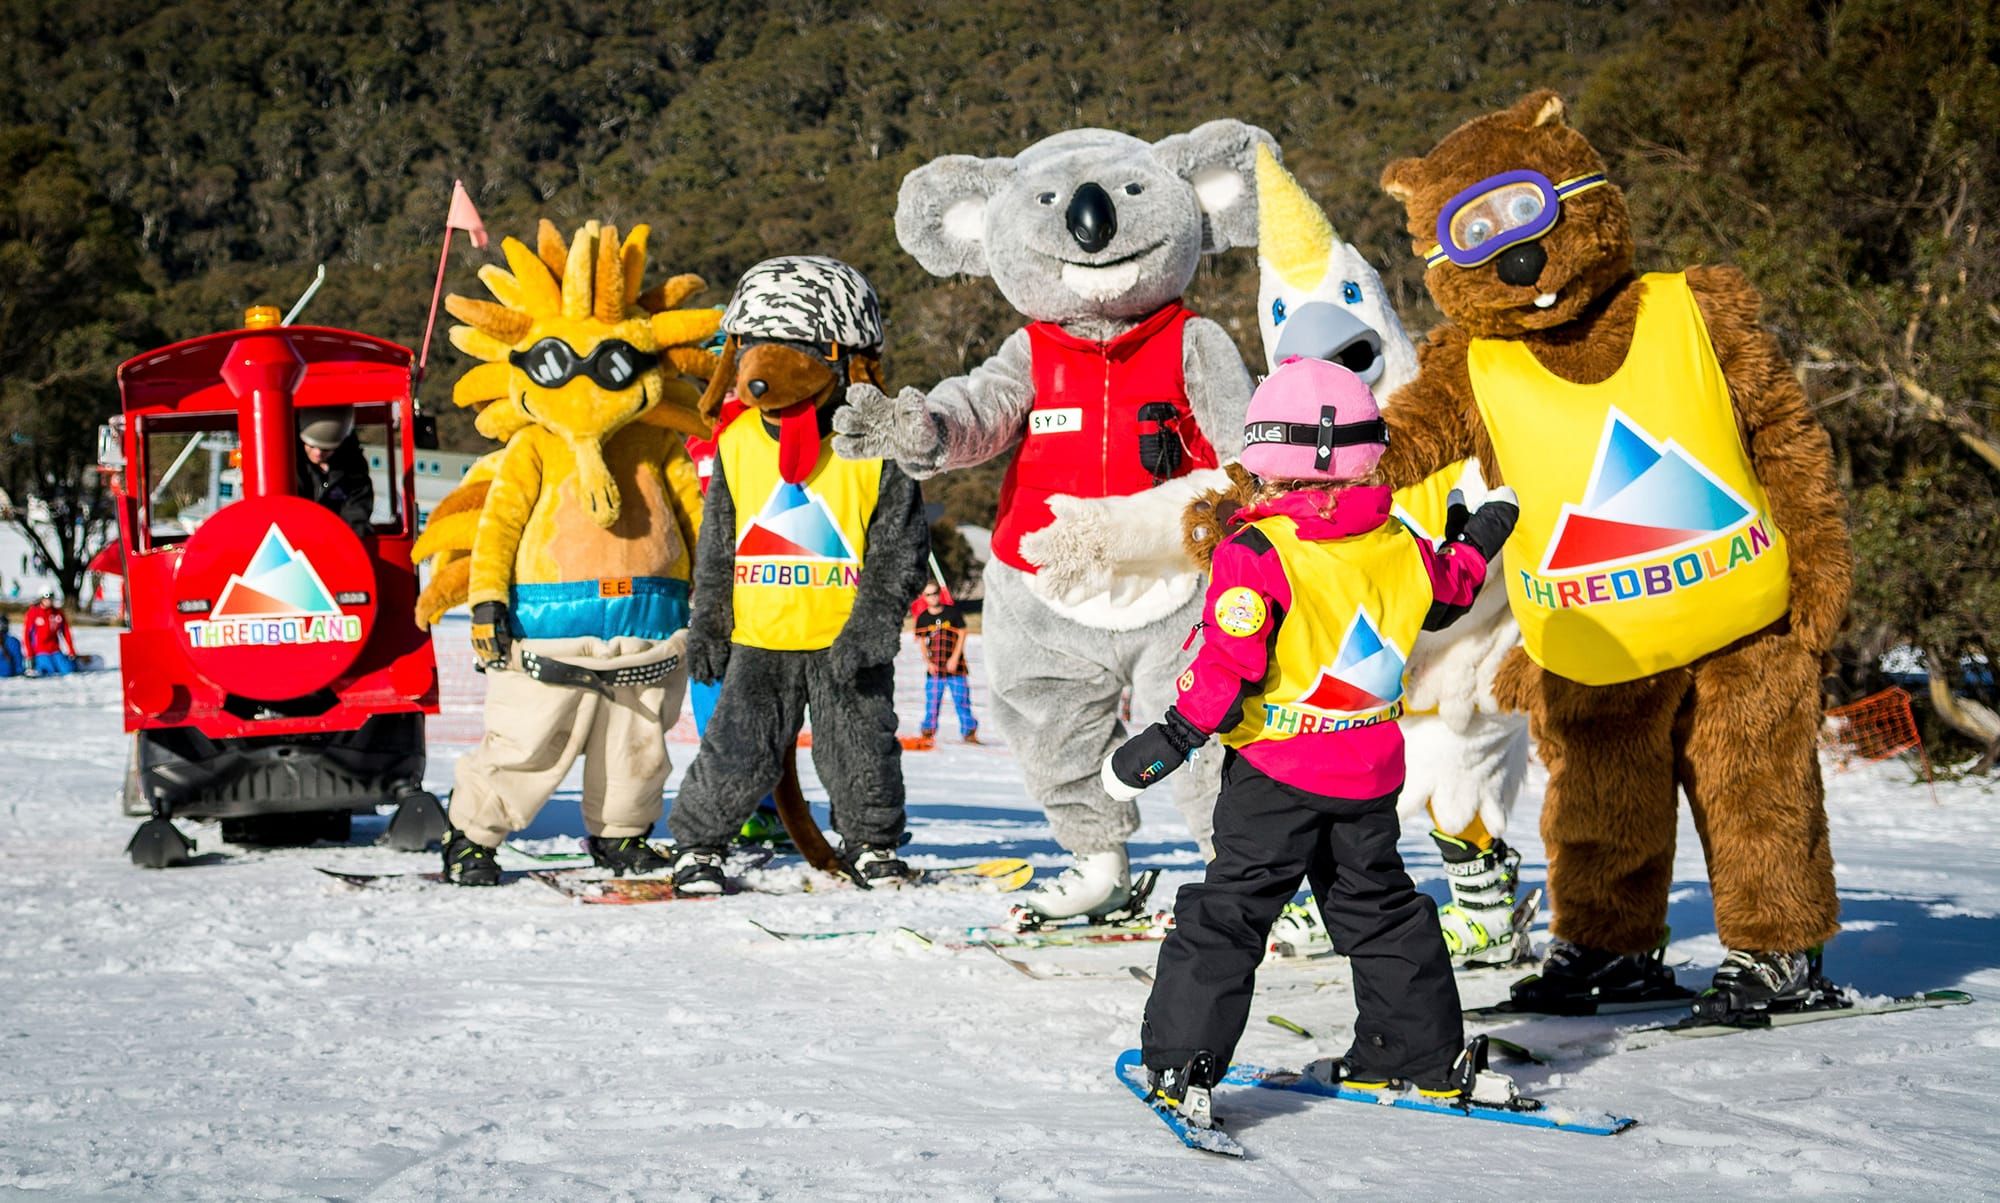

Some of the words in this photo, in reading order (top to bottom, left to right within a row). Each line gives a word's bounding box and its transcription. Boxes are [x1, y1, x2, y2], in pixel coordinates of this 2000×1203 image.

[1034, 414, 1068, 429] SYD
[1244, 423, 1283, 447] ollé
[188, 618, 361, 647] THREDBOLAND
